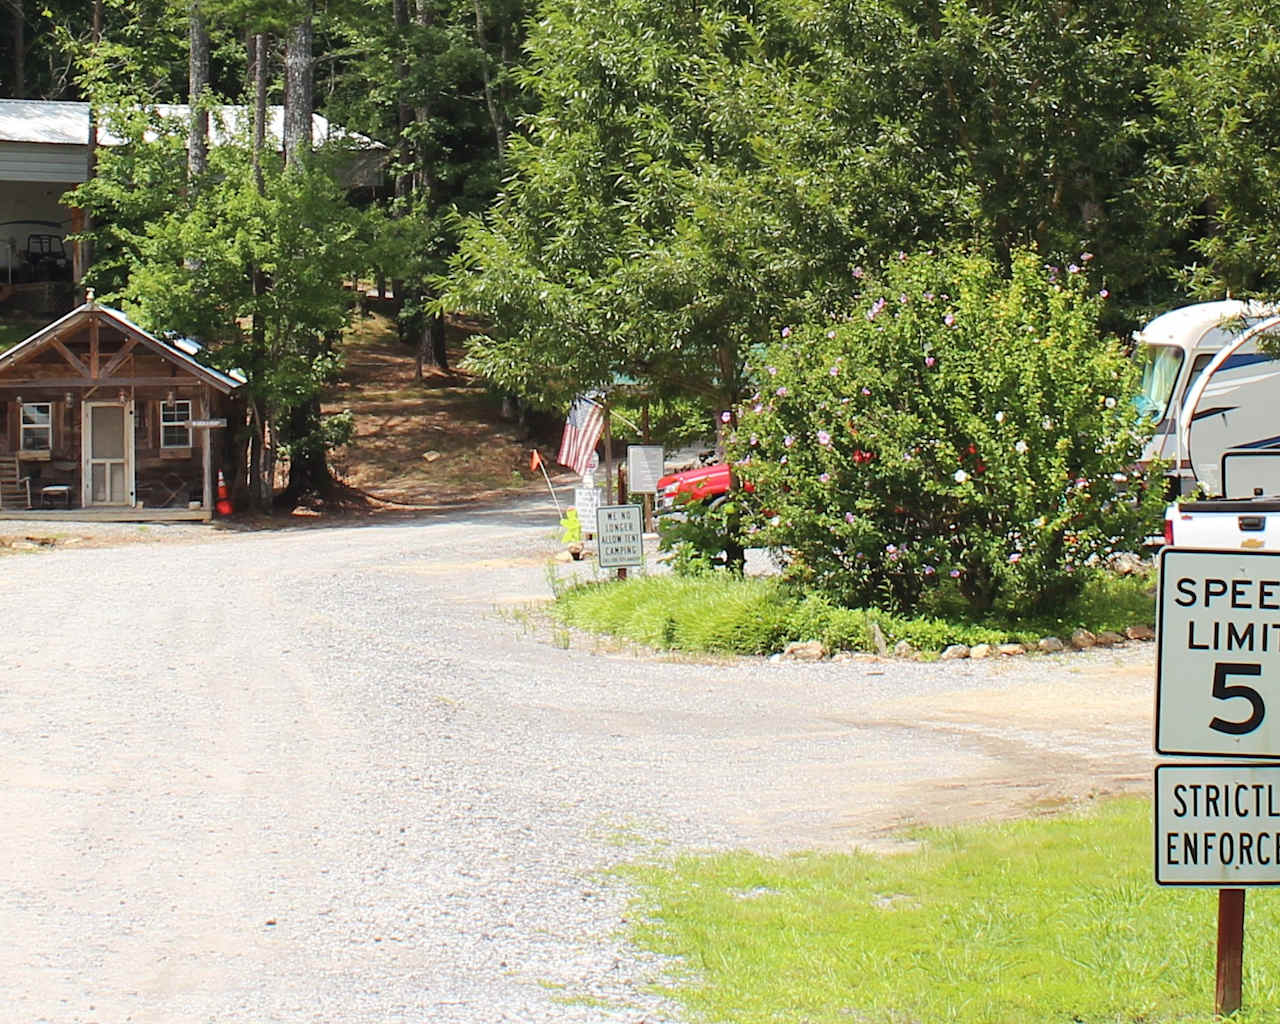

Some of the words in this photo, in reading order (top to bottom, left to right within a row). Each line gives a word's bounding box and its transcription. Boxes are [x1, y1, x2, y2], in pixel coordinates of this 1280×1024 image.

[607, 512, 617, 521] WE
[621, 511, 632, 520] NO
[605, 523, 633, 533] LONGER
[601, 535, 622, 544] ALLOW
[624, 534, 639, 544] TENT
[605, 546, 637, 556] CAMPING
[1209, 662, 1265, 735] 5
